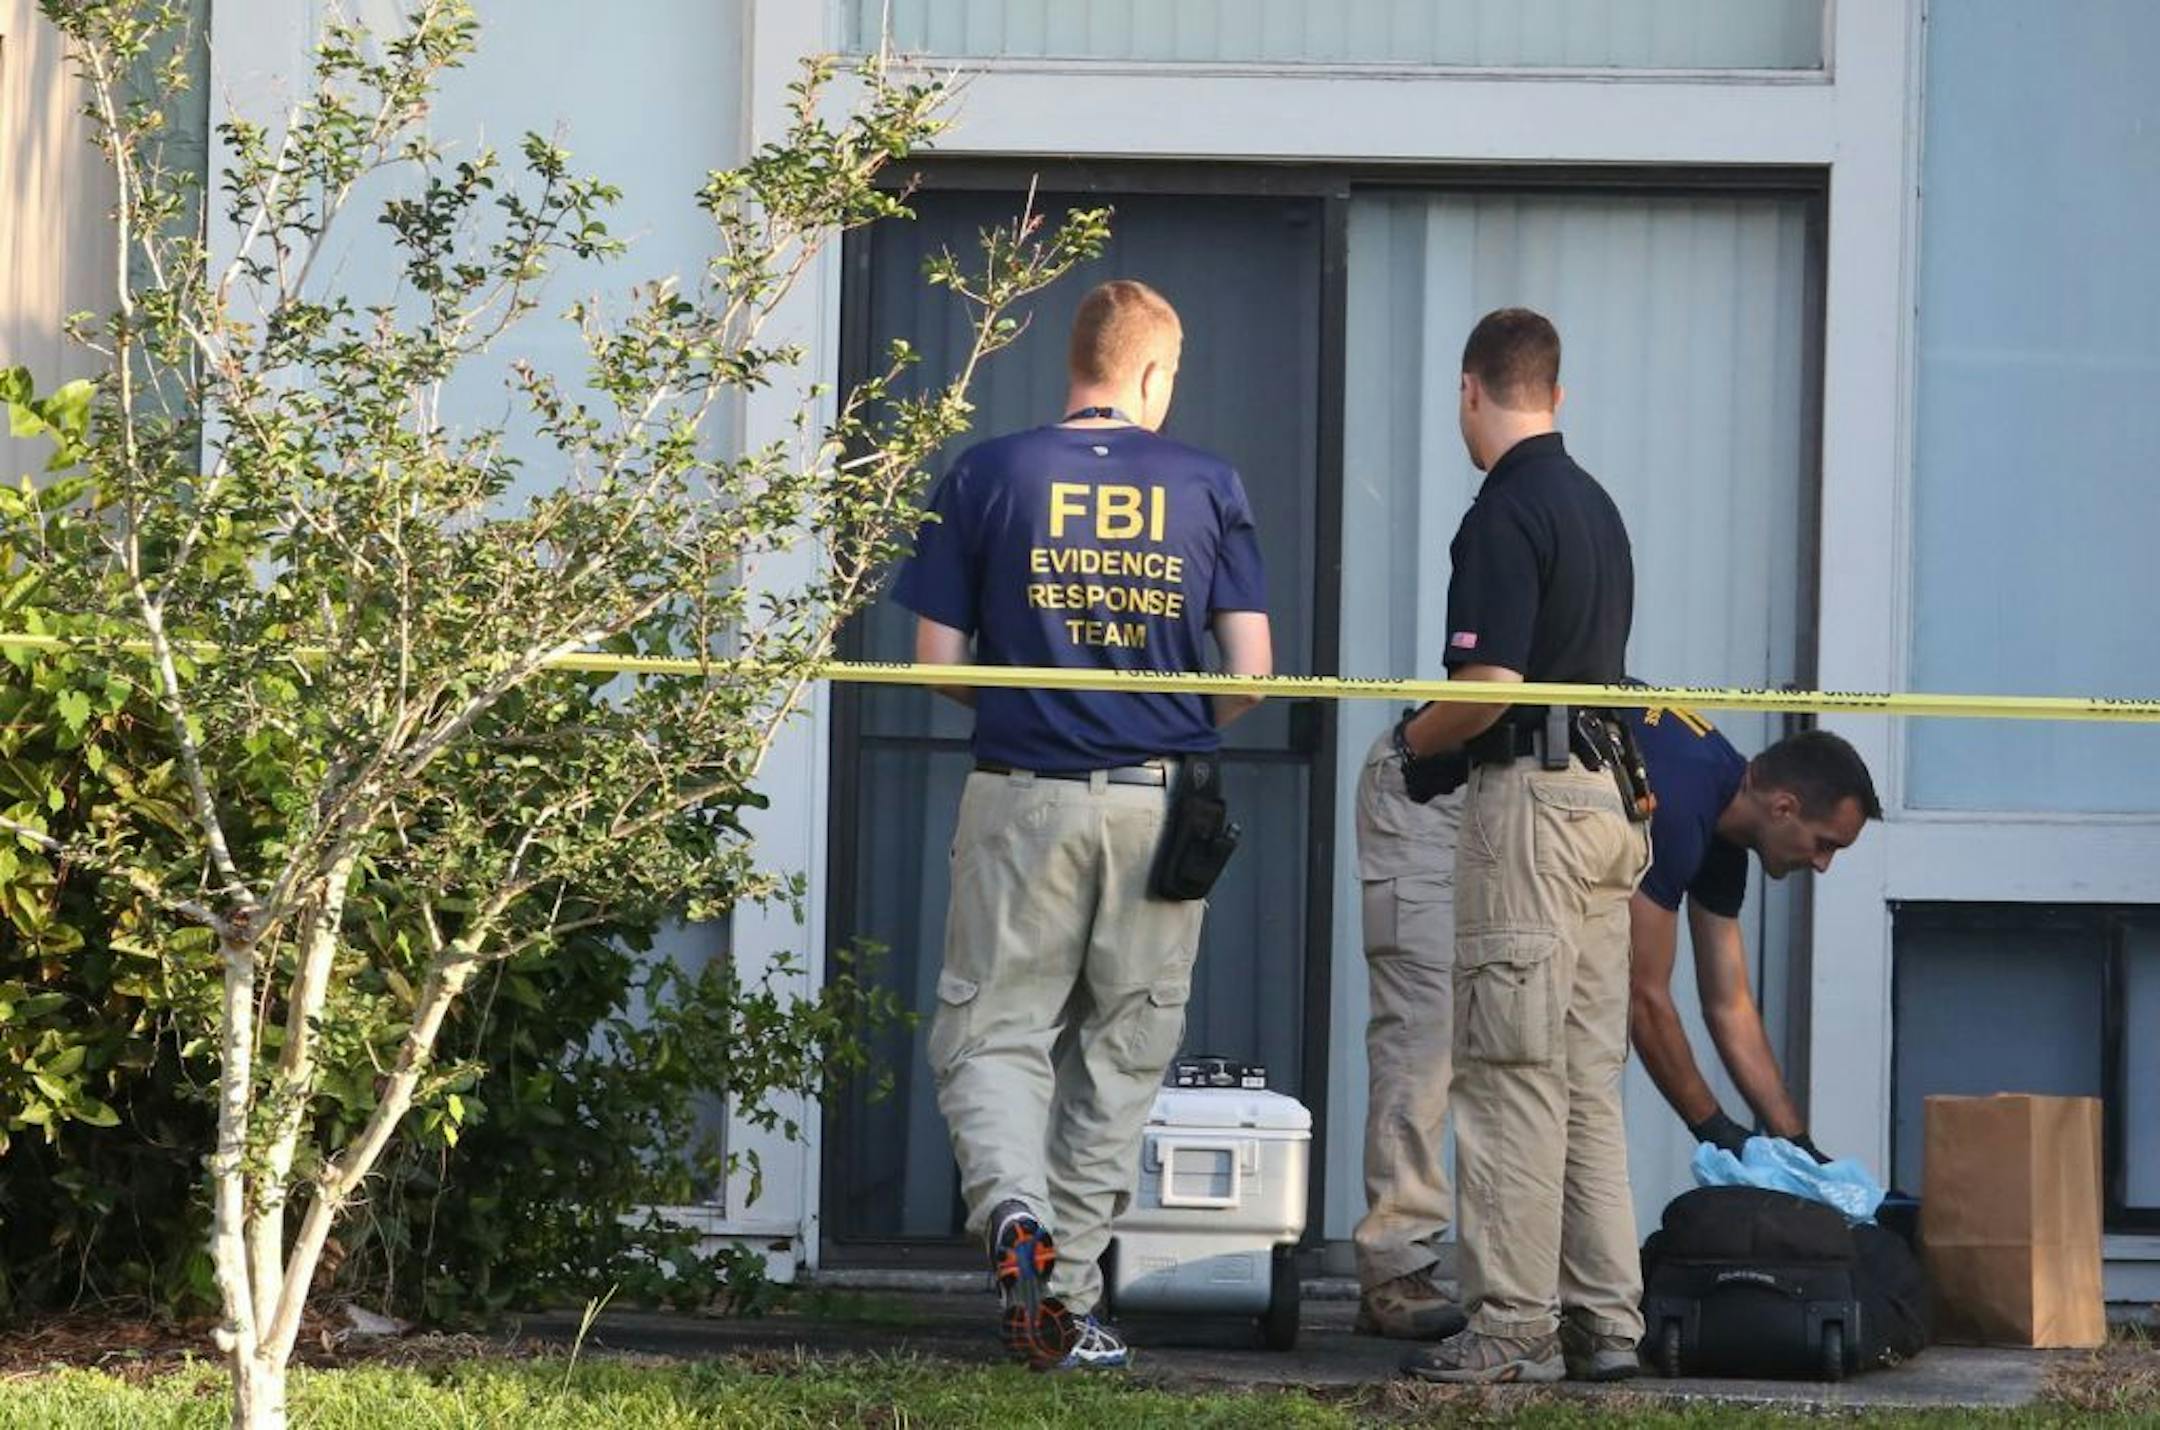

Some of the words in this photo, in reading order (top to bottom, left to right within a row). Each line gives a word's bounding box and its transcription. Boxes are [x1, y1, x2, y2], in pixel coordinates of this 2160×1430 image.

[1049, 481, 1166, 542] FBI
[1029, 548, 1184, 583] EVIDENCE
[1027, 583, 1185, 619] RESPONSE
[1065, 619, 1148, 649] TEAM
